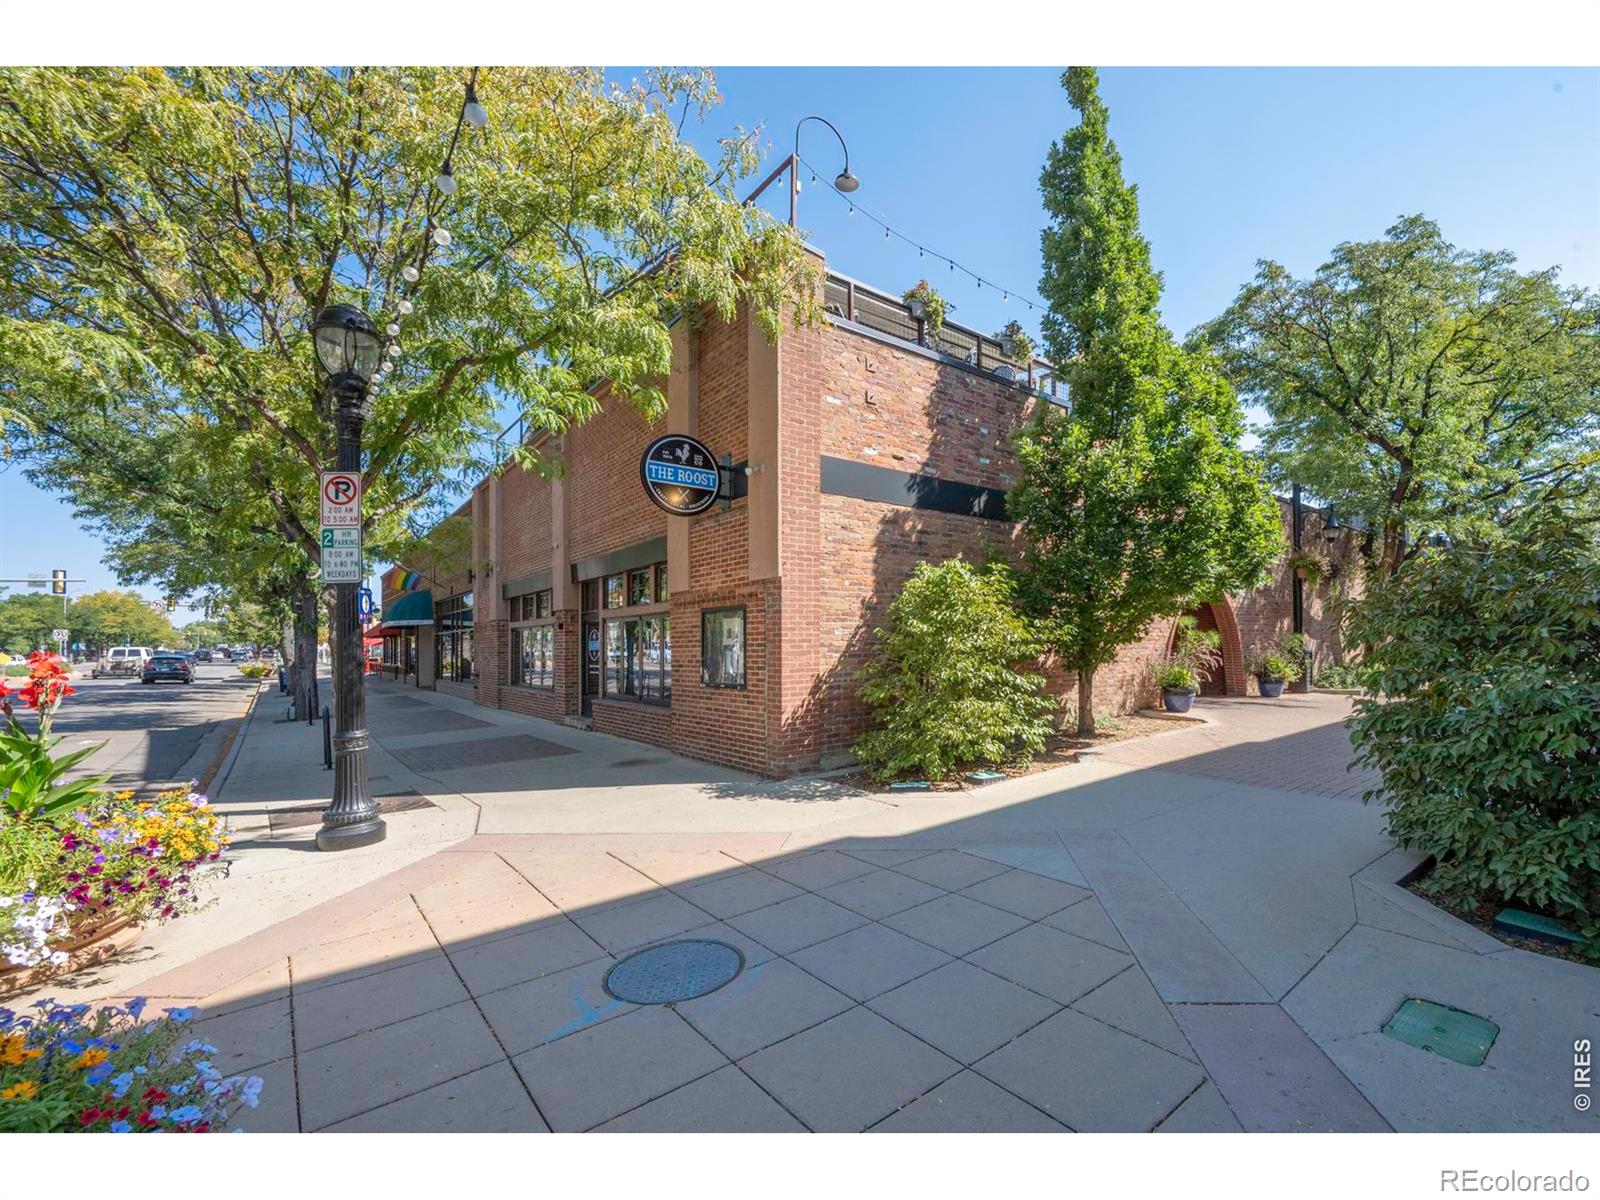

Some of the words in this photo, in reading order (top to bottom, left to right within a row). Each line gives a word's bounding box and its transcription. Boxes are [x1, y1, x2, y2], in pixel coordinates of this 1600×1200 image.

[649, 464, 674, 480] THE
[677, 469, 715, 486] ROOST
[328, 506, 342, 514] 2:00
[323, 531, 332, 546] 2
